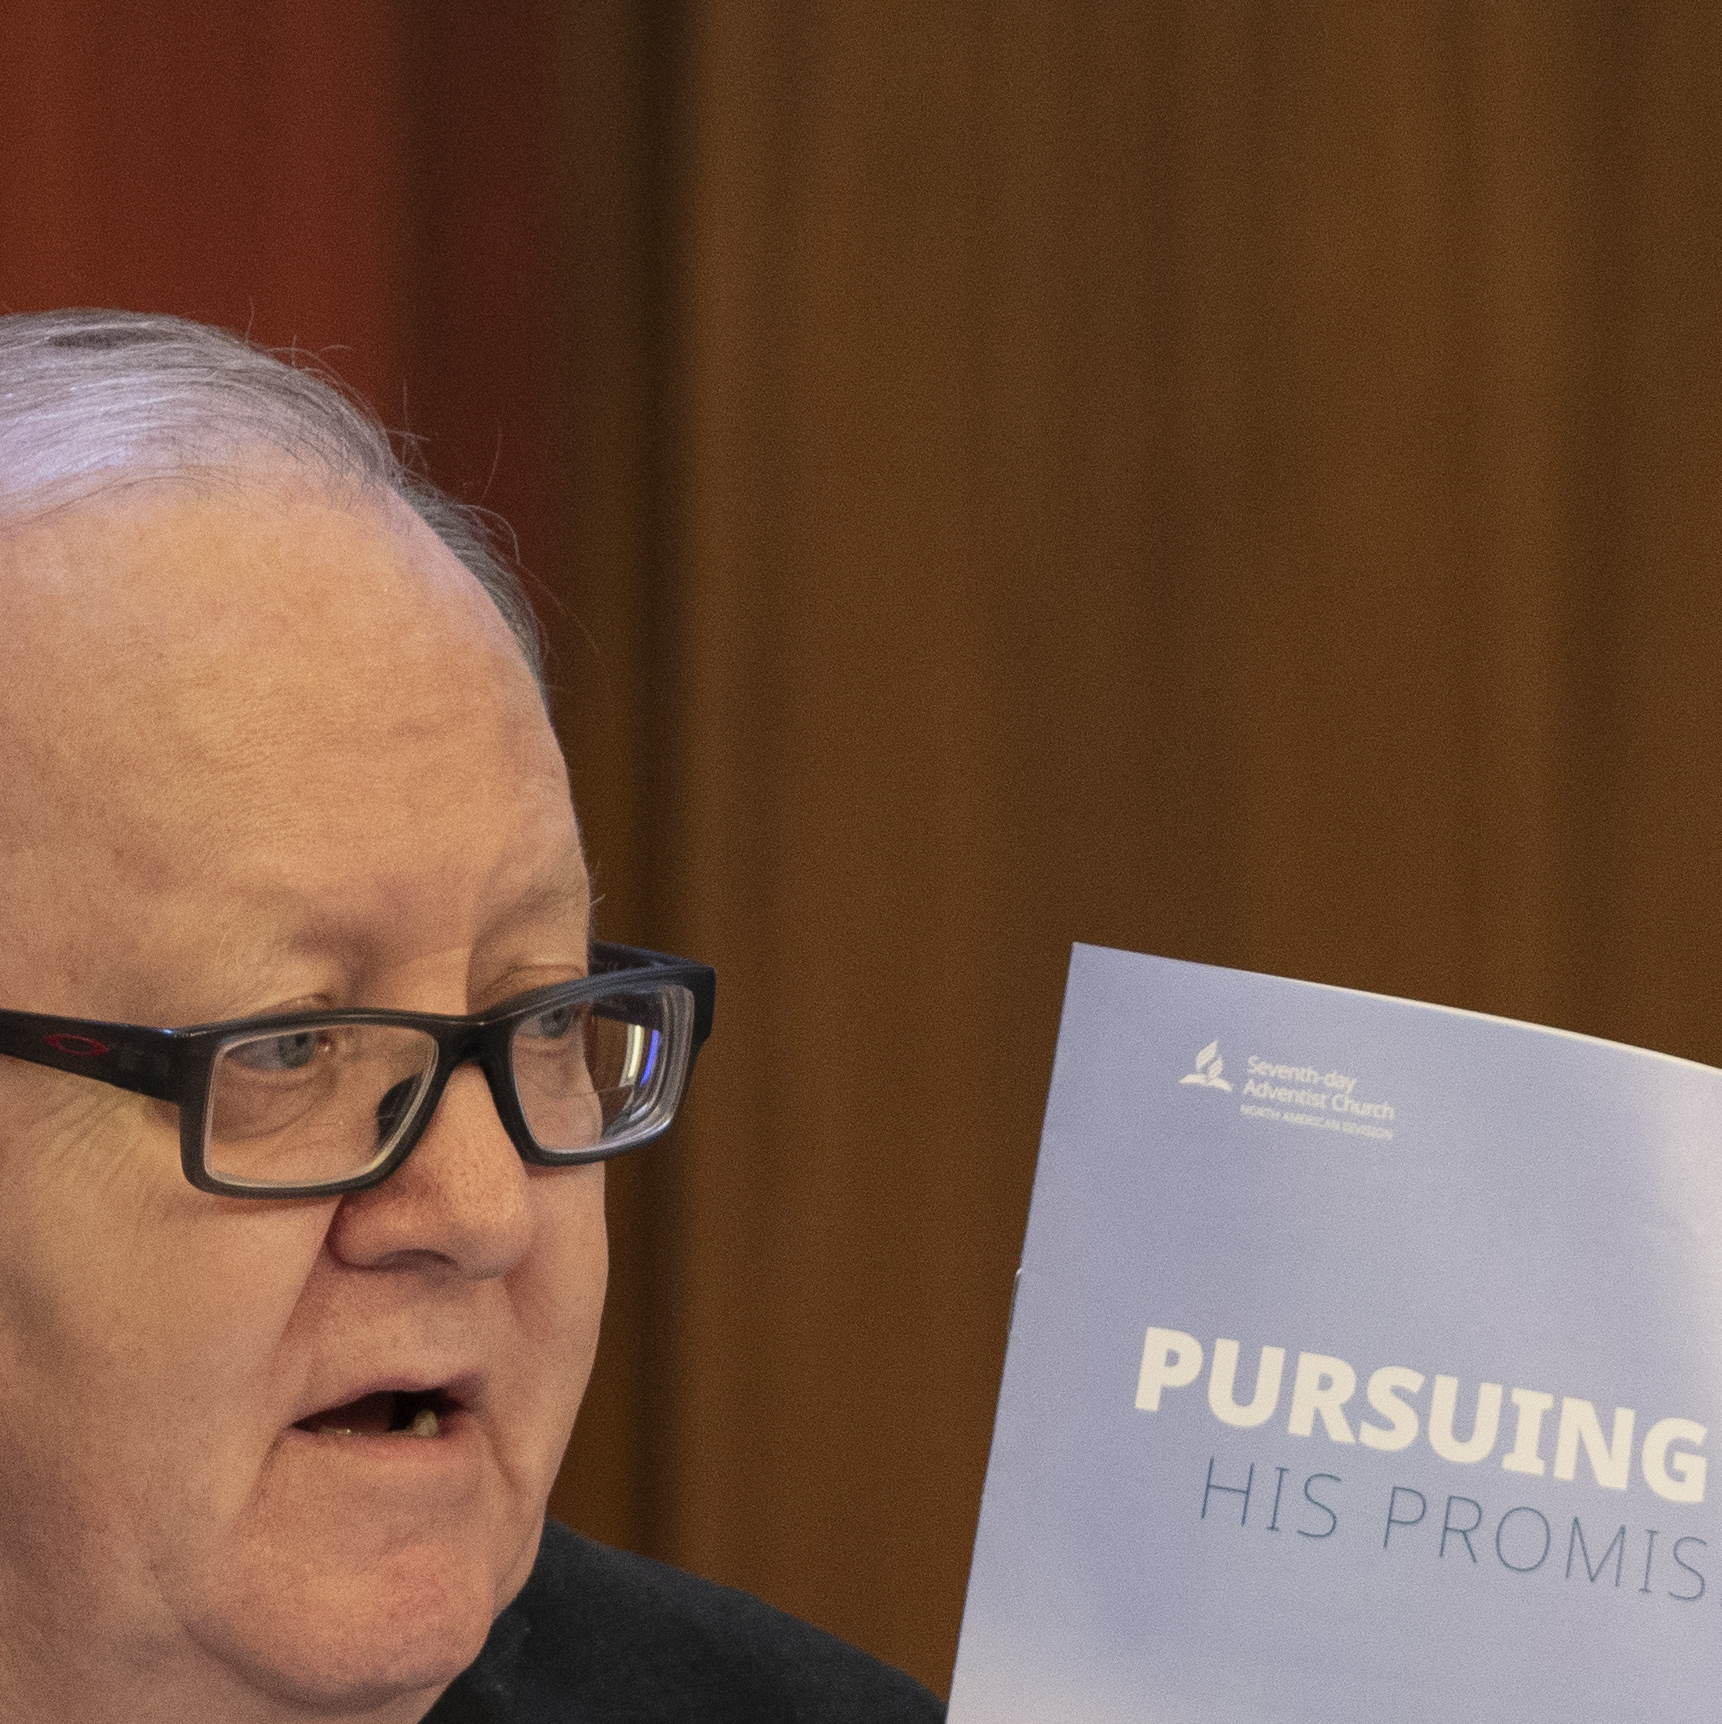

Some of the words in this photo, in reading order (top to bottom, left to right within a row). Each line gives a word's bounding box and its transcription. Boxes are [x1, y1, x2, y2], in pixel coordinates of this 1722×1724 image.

[1242, 1078, 1328, 1109] Adventist
[1331, 1094, 1396, 1121] Church
[1247, 1055, 1358, 1094] Seventh-day
[1134, 1326, 1709, 1503] PURSUING
[1200, 1456, 1342, 1538] HIS
